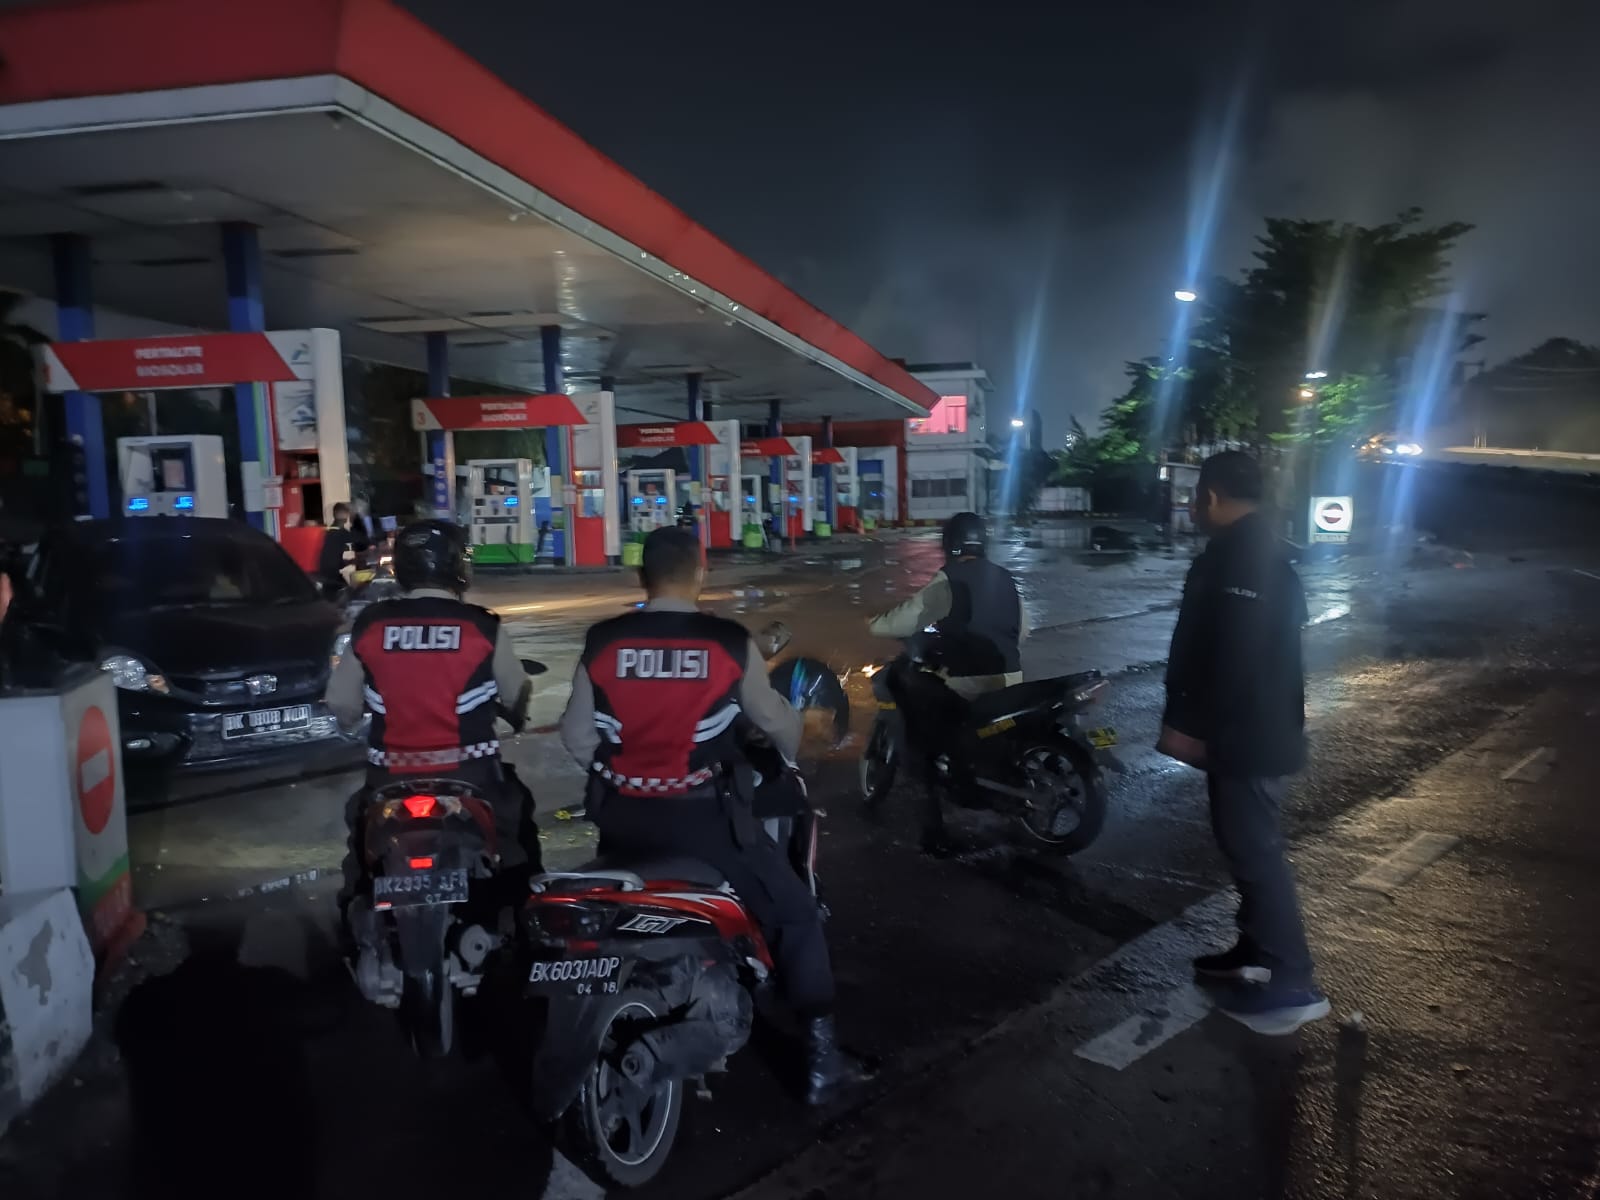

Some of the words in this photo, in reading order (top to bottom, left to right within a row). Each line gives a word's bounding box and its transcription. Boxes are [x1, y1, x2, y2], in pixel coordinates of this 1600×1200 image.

[383, 624, 461, 651] POLISI
[616, 647, 709, 679] POLISI
[528, 957, 621, 983] BK6031ADP
[577, 982, 592, 995] 04
